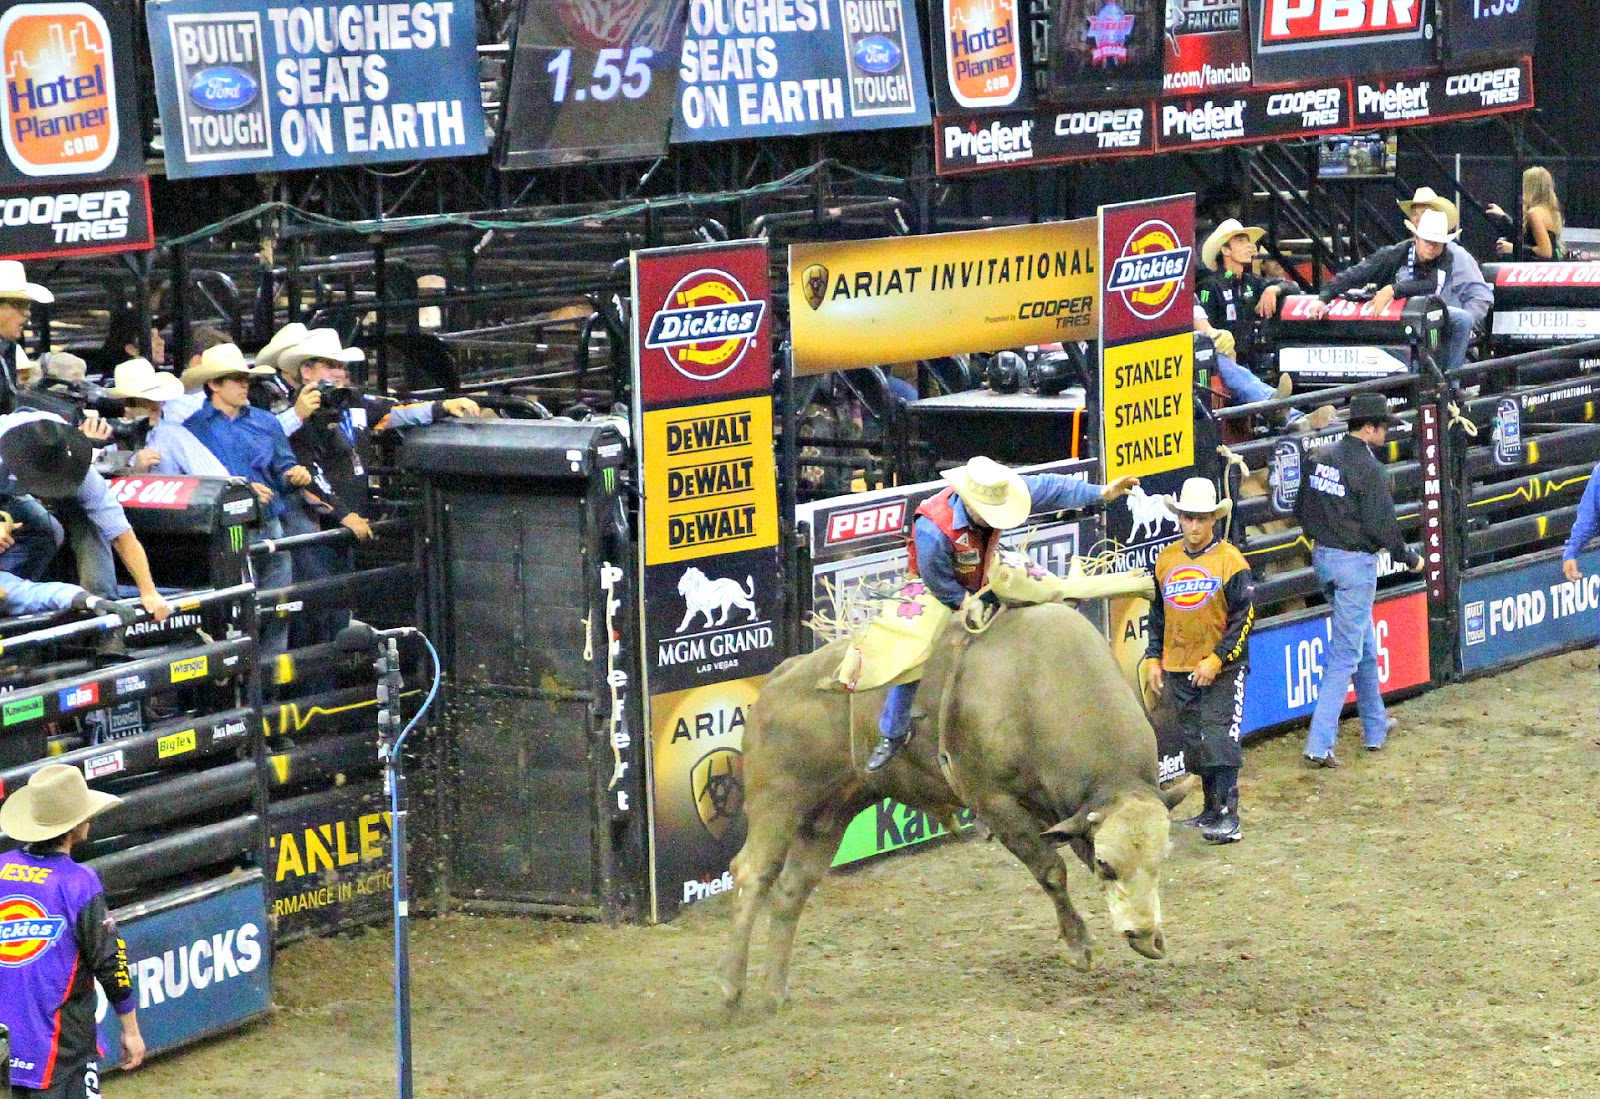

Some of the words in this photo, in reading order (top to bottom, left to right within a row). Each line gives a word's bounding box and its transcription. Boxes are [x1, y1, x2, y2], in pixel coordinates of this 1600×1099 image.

[268, 2, 454, 55] TOUGHEST
[686, 0, 830, 36] OUGHEST
[847, 2, 898, 33] BUILT
[1271, 0, 1413, 35] PBR
[181, 23, 256, 65] BUILT
[865, 45, 889, 63] Ford
[951, 25, 1012, 58] Hotel
[547, 46, 653, 103] 1.55
[680, 36, 778, 83] SEATS
[955, 52, 1015, 80] Planner
[8, 64, 107, 112] Hotel
[206, 76, 241, 98] Ford
[275, 55, 389, 106] SEATS
[854, 76, 907, 104] TOUGH
[1358, 82, 1428, 113] Priefert
[1446, 67, 1520, 96] COOPER
[1480, 87, 1519, 106] TIRES
[682, 88, 730, 129] ON
[740, 79, 845, 125] EARTH
[1162, 100, 1243, 136] Priefert
[1267, 88, 1341, 116] COOPER
[1302, 109, 1339, 127] TIRES
[15, 106, 108, 143] Planner
[189, 111, 265, 150] TOUGH
[281, 107, 334, 157] ON
[345, 100, 466, 152] EARTH
[945, 120, 1032, 158] Priefert
[1055, 108, 1143, 136] COOPER
[1097, 130, 1141, 148] TIRES
[0, 190, 130, 227] OOPER
[52, 218, 129, 243] TIRES
[831, 266, 922, 301] ARIAT
[930, 247, 1094, 291] INVITATIONAL
[1116, 255, 1184, 284] Dickies
[658, 310, 754, 340] Dickies
[1019, 296, 1092, 319] COOPER
[1056, 313, 1091, 329] TIRES
[1115, 355, 1183, 389] STANLEY
[1115, 393, 1182, 428] STANLEY
[1116, 431, 1183, 466] STANLEY
[139, 479, 184, 504] OIL
[831, 504, 901, 540] PBR
[1165, 579, 1214, 597] Dickies
[1490, 590, 1547, 636] FORD
[658, 638, 706, 667] MGM
[710, 626, 773, 658] GRAND
[697, 665, 711, 674] LAS
[714, 659, 738, 671] VEGAS
[1285, 636, 1323, 709] LAS
[671, 704, 751, 744] ARIA
[275, 888, 334, 916] RMANCE
[127, 923, 262, 1009] TRUCKS
